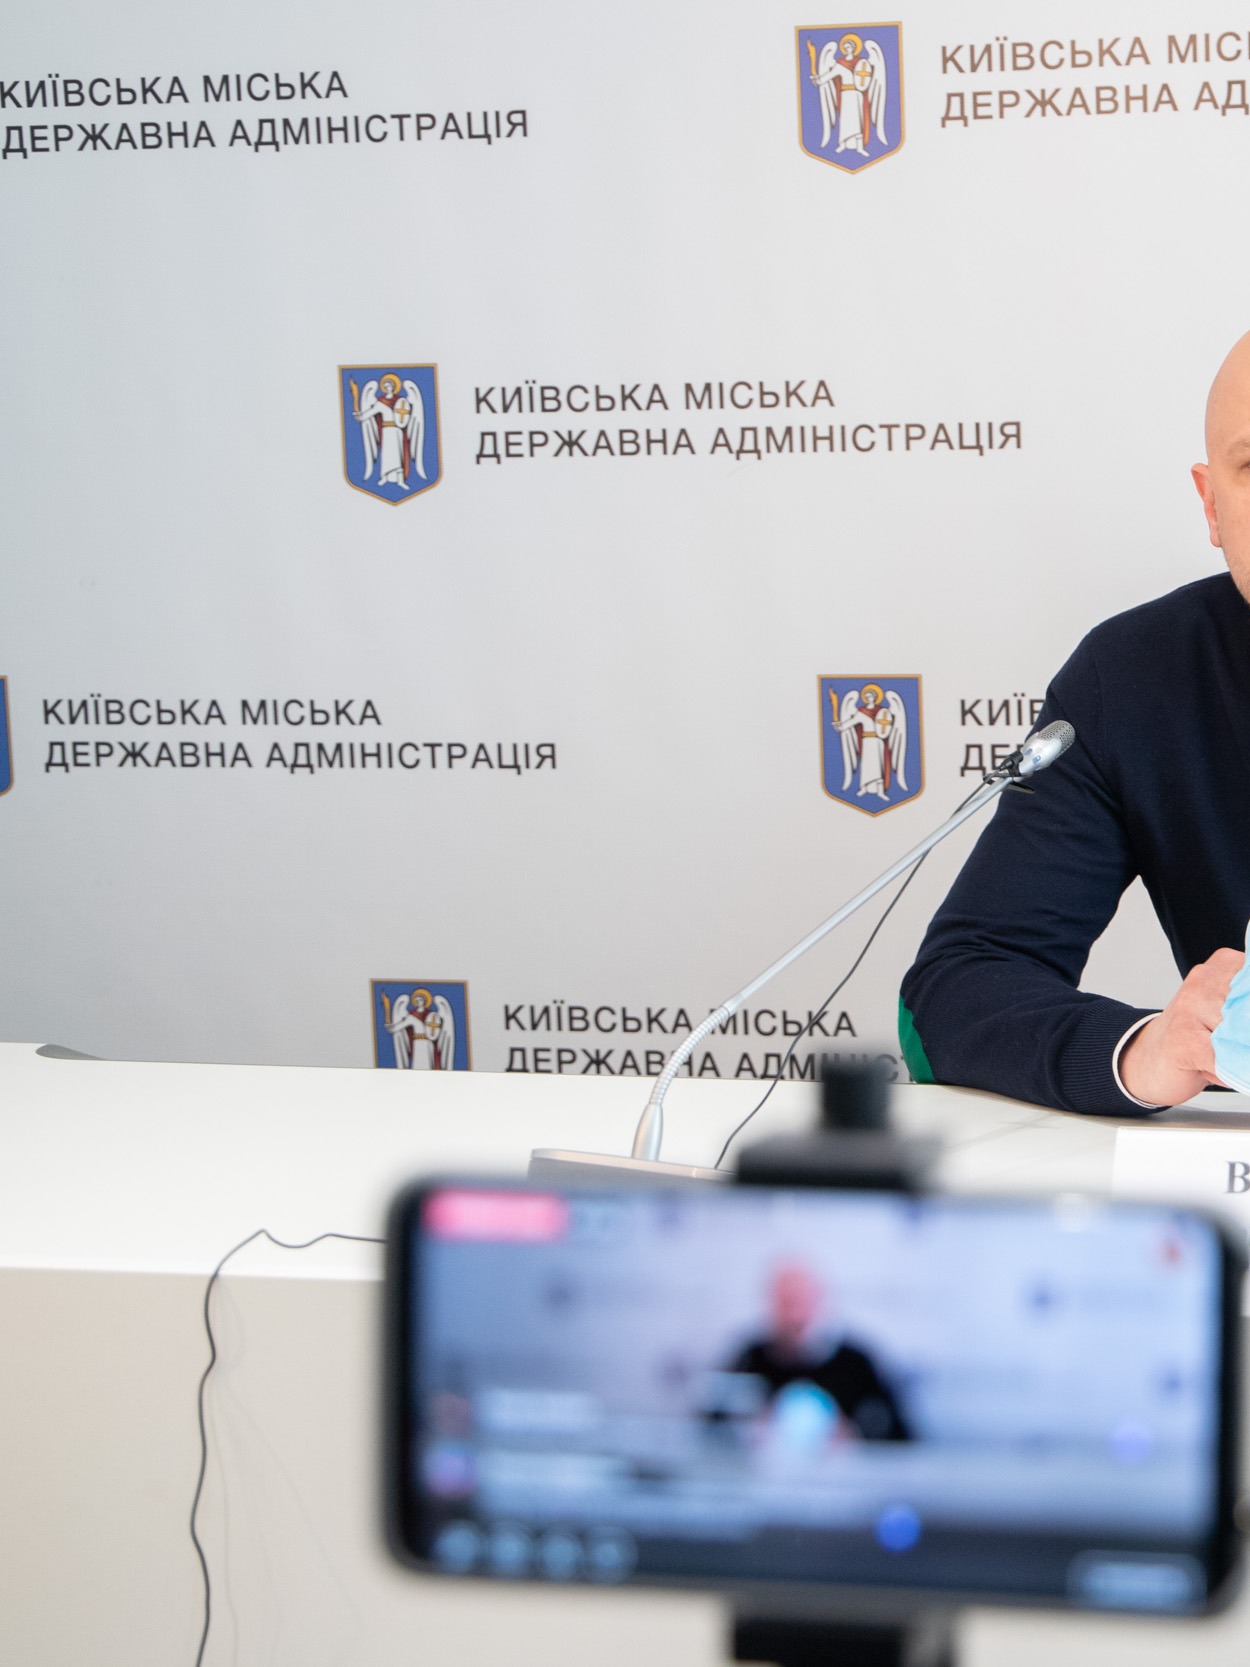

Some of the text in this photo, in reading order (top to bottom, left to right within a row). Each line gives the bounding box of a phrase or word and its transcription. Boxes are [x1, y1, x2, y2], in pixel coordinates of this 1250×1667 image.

[942, 36, 1150, 76] КИЇВСЬКА
[0, 71, 349, 109] КИЇВСЬКА МІСЬКА
[941, 83, 1180, 130] ДЕРЖАВНА
[2, 110, 529, 160] ДЕРЖАВНА АДМІНІСТРАЦІЯ
[475, 380, 836, 416] КИЇВСЬКА МІСЬКА
[476, 422, 1023, 466] ДЕРЖАВНА АДМІНІСТРАЦІЯ
[43, 693, 383, 728] КИЇВСЬКА МІСЬКА
[45, 741, 558, 777] ДЕРЖАВНА АДМІНІСТРАЦІЯ
[504, 999, 692, 1034] КИЇВСЬКА
